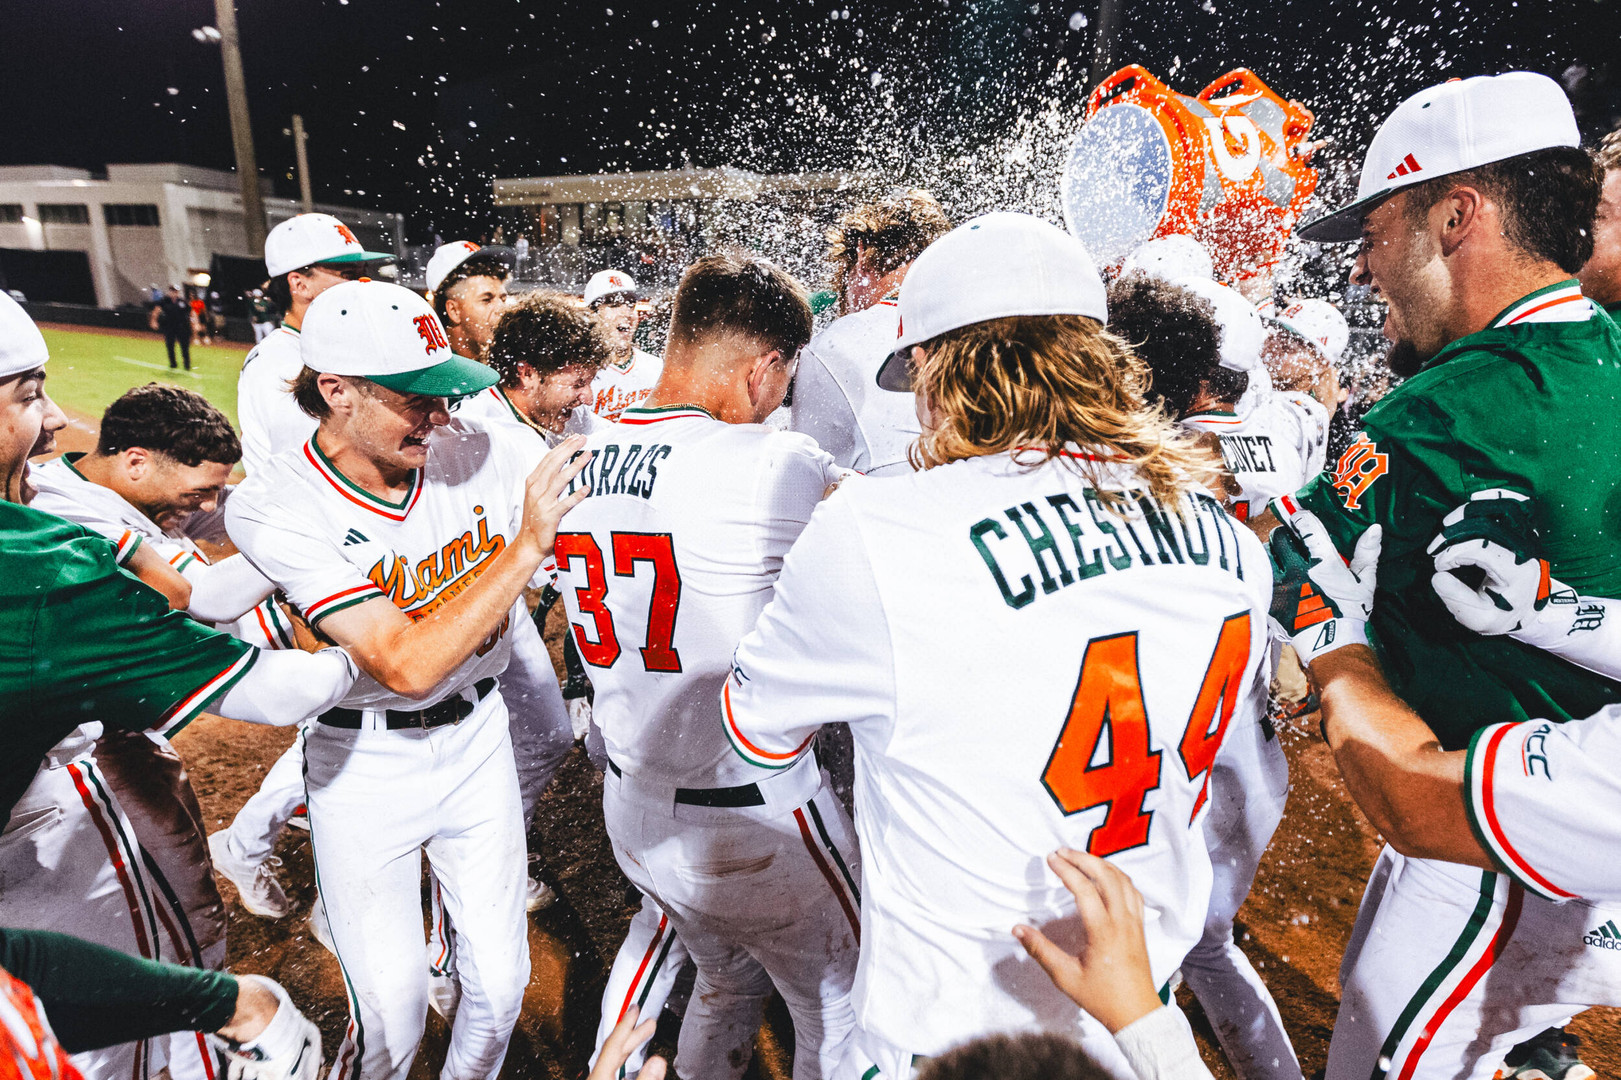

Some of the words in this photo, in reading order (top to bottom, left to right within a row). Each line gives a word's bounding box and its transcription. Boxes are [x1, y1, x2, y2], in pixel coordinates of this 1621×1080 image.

[367, 505, 506, 610] Miami
[554, 531, 683, 674] 37
[1040, 608, 1252, 858] 44
